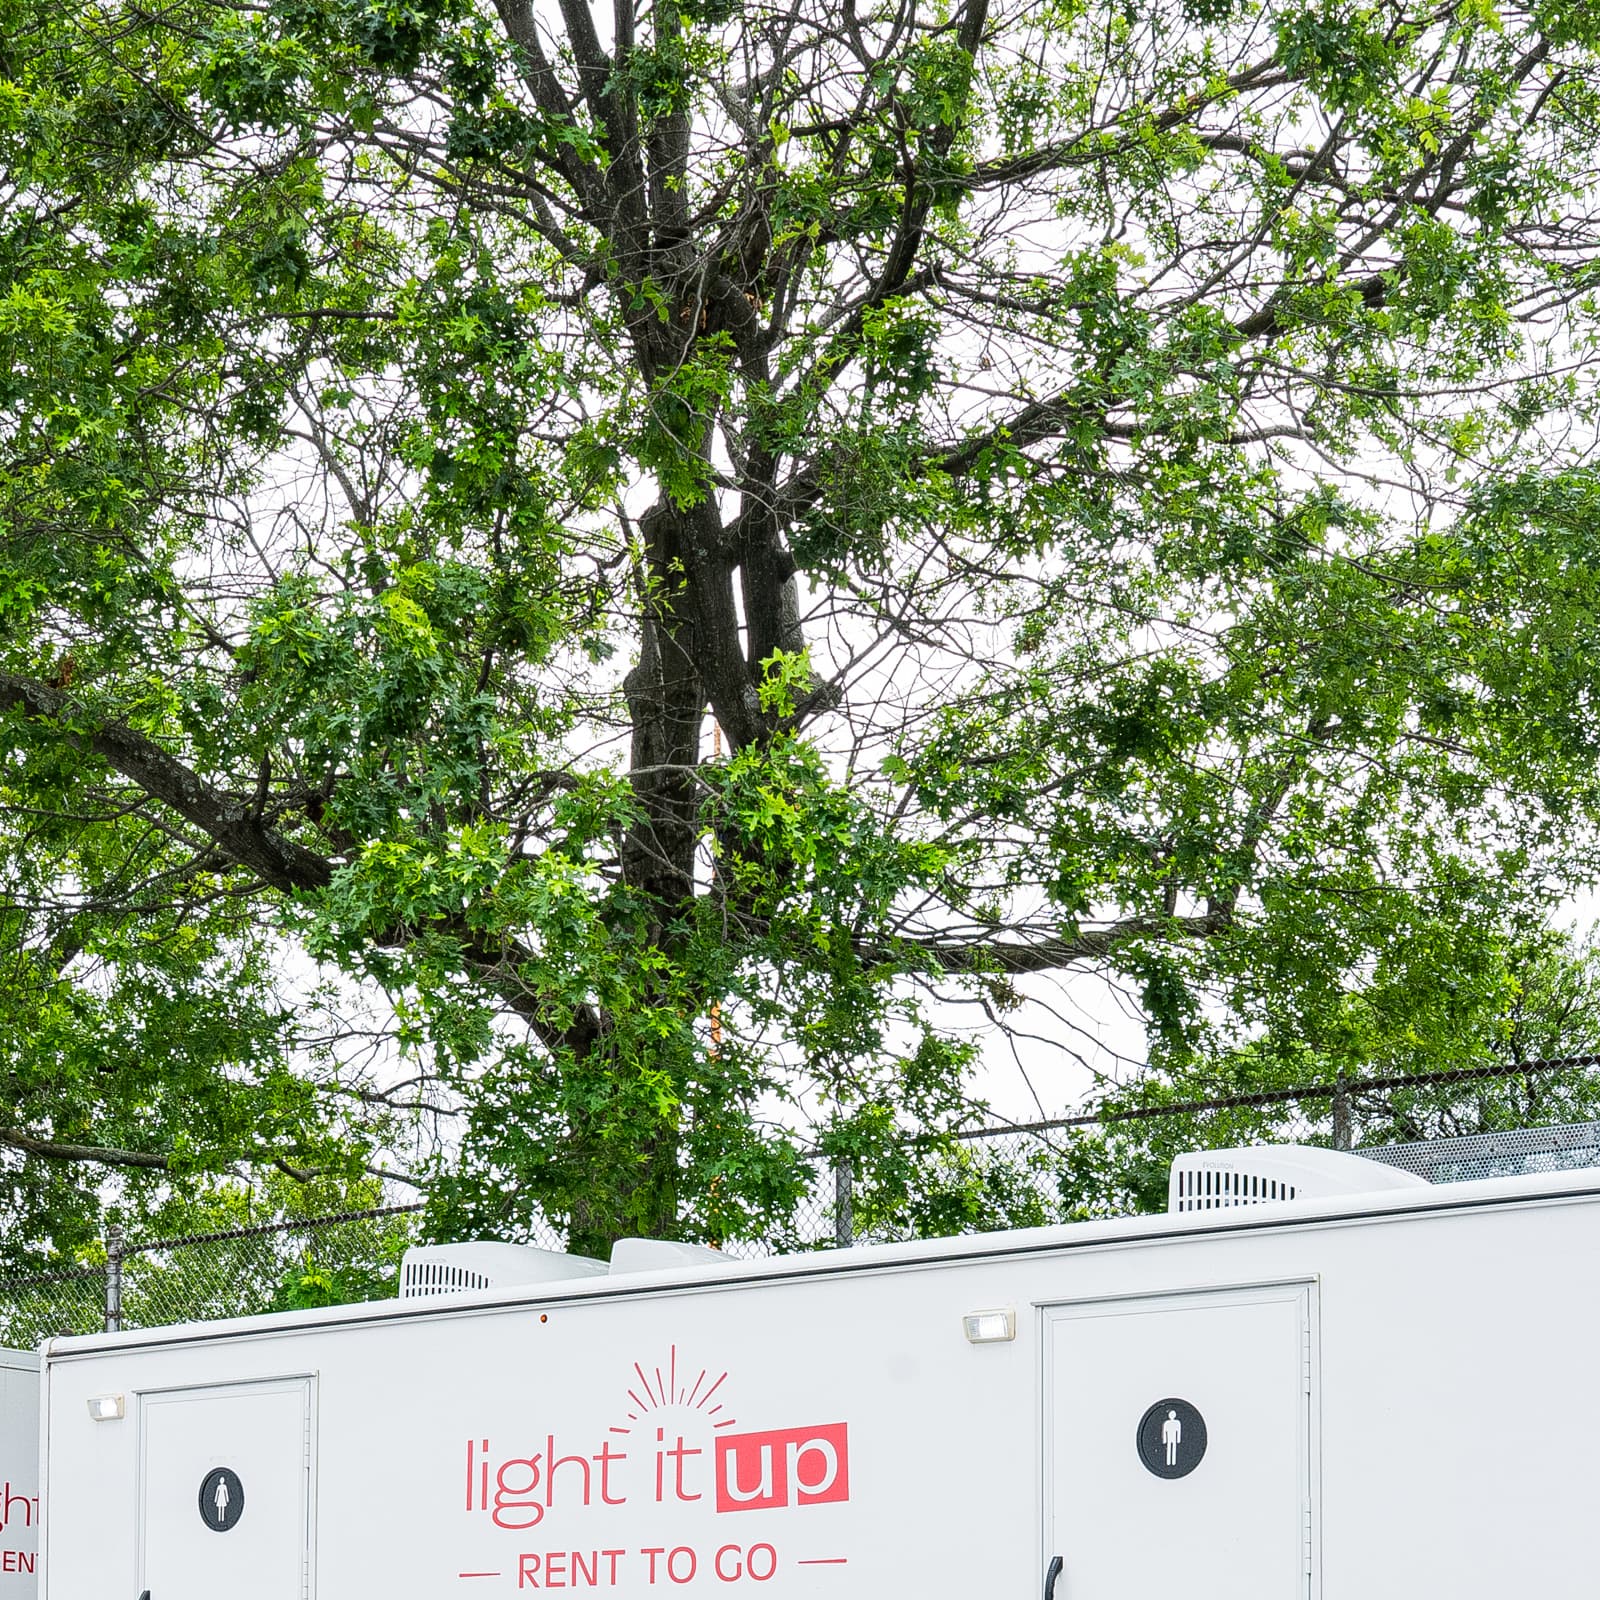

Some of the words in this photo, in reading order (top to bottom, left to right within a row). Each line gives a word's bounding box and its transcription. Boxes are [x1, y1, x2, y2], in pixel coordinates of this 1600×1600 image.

[465, 1434, 627, 1530] light
[655, 1427, 702, 1502] it
[725, 1437, 839, 1507] up
[518, 1549, 626, 1589] RENT
[640, 1546, 697, 1584] TO
[714, 1542, 777, 1582] GO
